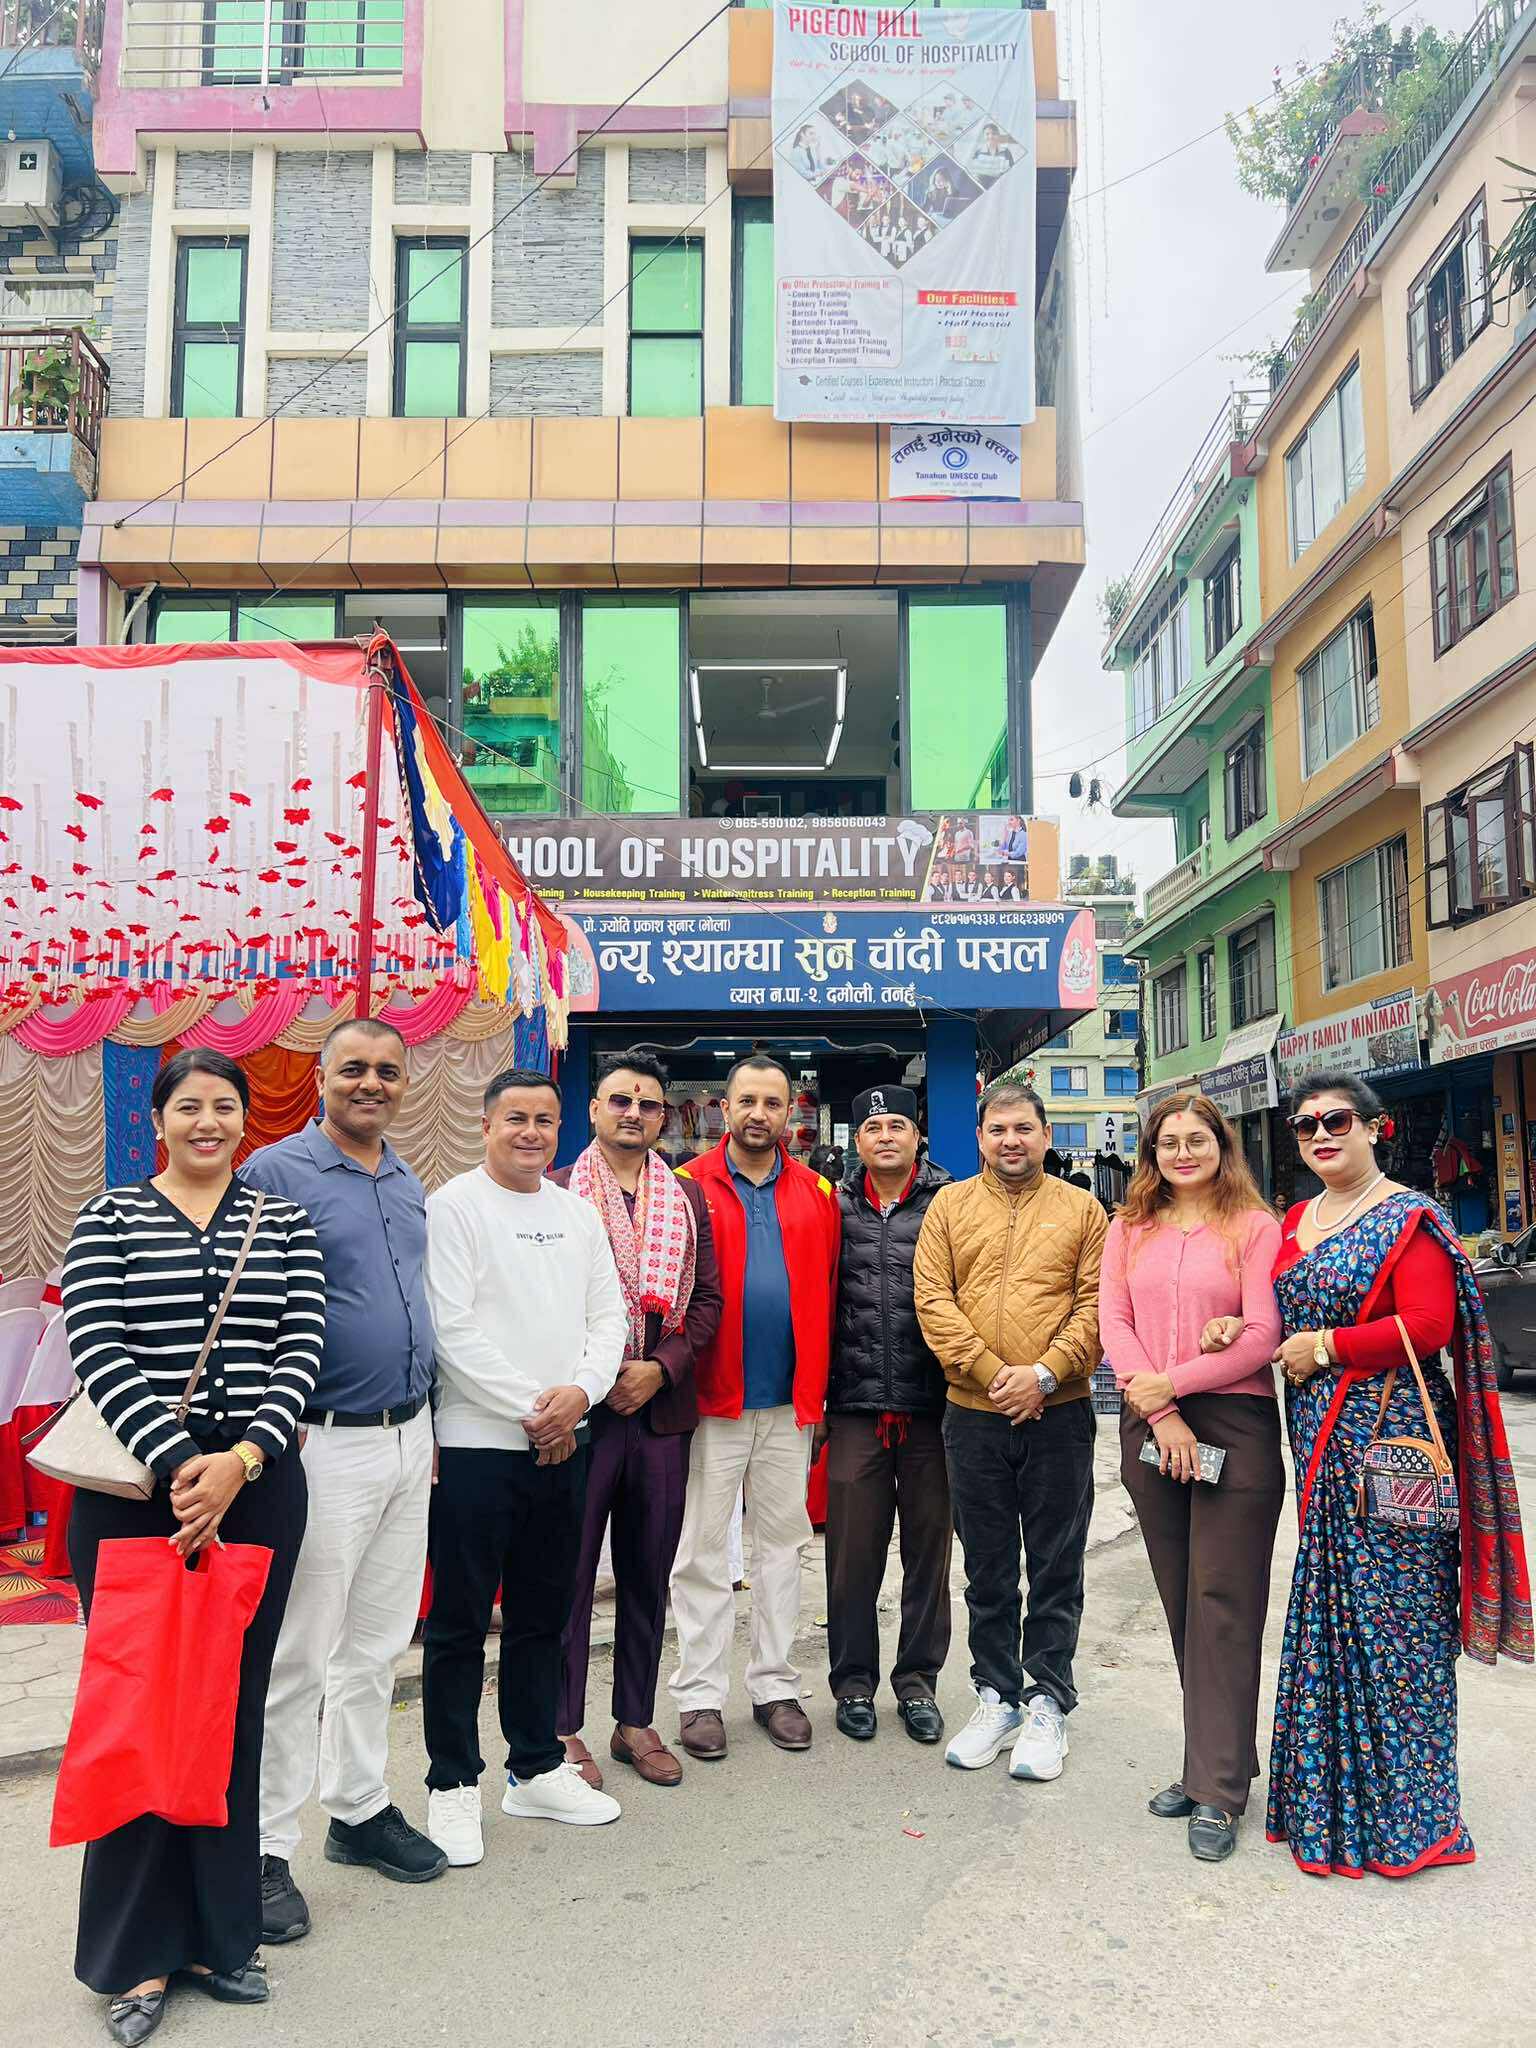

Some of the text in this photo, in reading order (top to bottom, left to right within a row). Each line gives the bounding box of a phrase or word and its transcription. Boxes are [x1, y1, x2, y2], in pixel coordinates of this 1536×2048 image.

[788, 7, 922, 38] PIGEON HILL
[830, 42, 1018, 63] SCHOOL OF HOSPITALITY
[792, 290, 851, 299] Cooking Training
[927, 293, 1009, 305] Our Facilities:
[792, 299, 847, 308] Bakery Training
[820, 309, 848, 317] Training
[971, 310, 1010, 318] Hostel
[829, 319, 858, 327] Training
[971, 320, 1012, 328] Hostel
[842, 328, 871, 337] Training
[859, 337, 887, 347] Training
[828, 356, 857, 364] Training
[928, 427, 983, 447] युनेस्को
[984, 438, 1020, 464] क्लब
[915, 472, 998, 480] Tanahun UNESCO Club
[508, 836, 922, 878] HOOL OF HOSPITALITY
[583, 888, 646, 900] Housekeeping
[649, 888, 686, 900] Training
[777, 888, 814, 900] Training
[832, 888, 877, 899] Reception
[880, 888, 916, 899] Training
[599, 916, 631, 933] ज्योति
[634, 918, 665, 934] प्रकाश
[667, 918, 697, 935] सुनार
[699, 915, 731, 933] (भोला)
[599, 940, 656, 985] न्यू
[794, 938, 857, 982] सुन
[867, 926, 946, 974] चाँदी
[956, 937, 1050, 974] पसल
[730, 986, 766, 1005] व्यास
[1279, 1031, 1310, 1059] HAPPY
[1312, 1021, 1348, 1050] FAMILY
[1351, 1001, 1411, 1040] MINIMART
[1105, 1116, 1116, 1151] ATM
